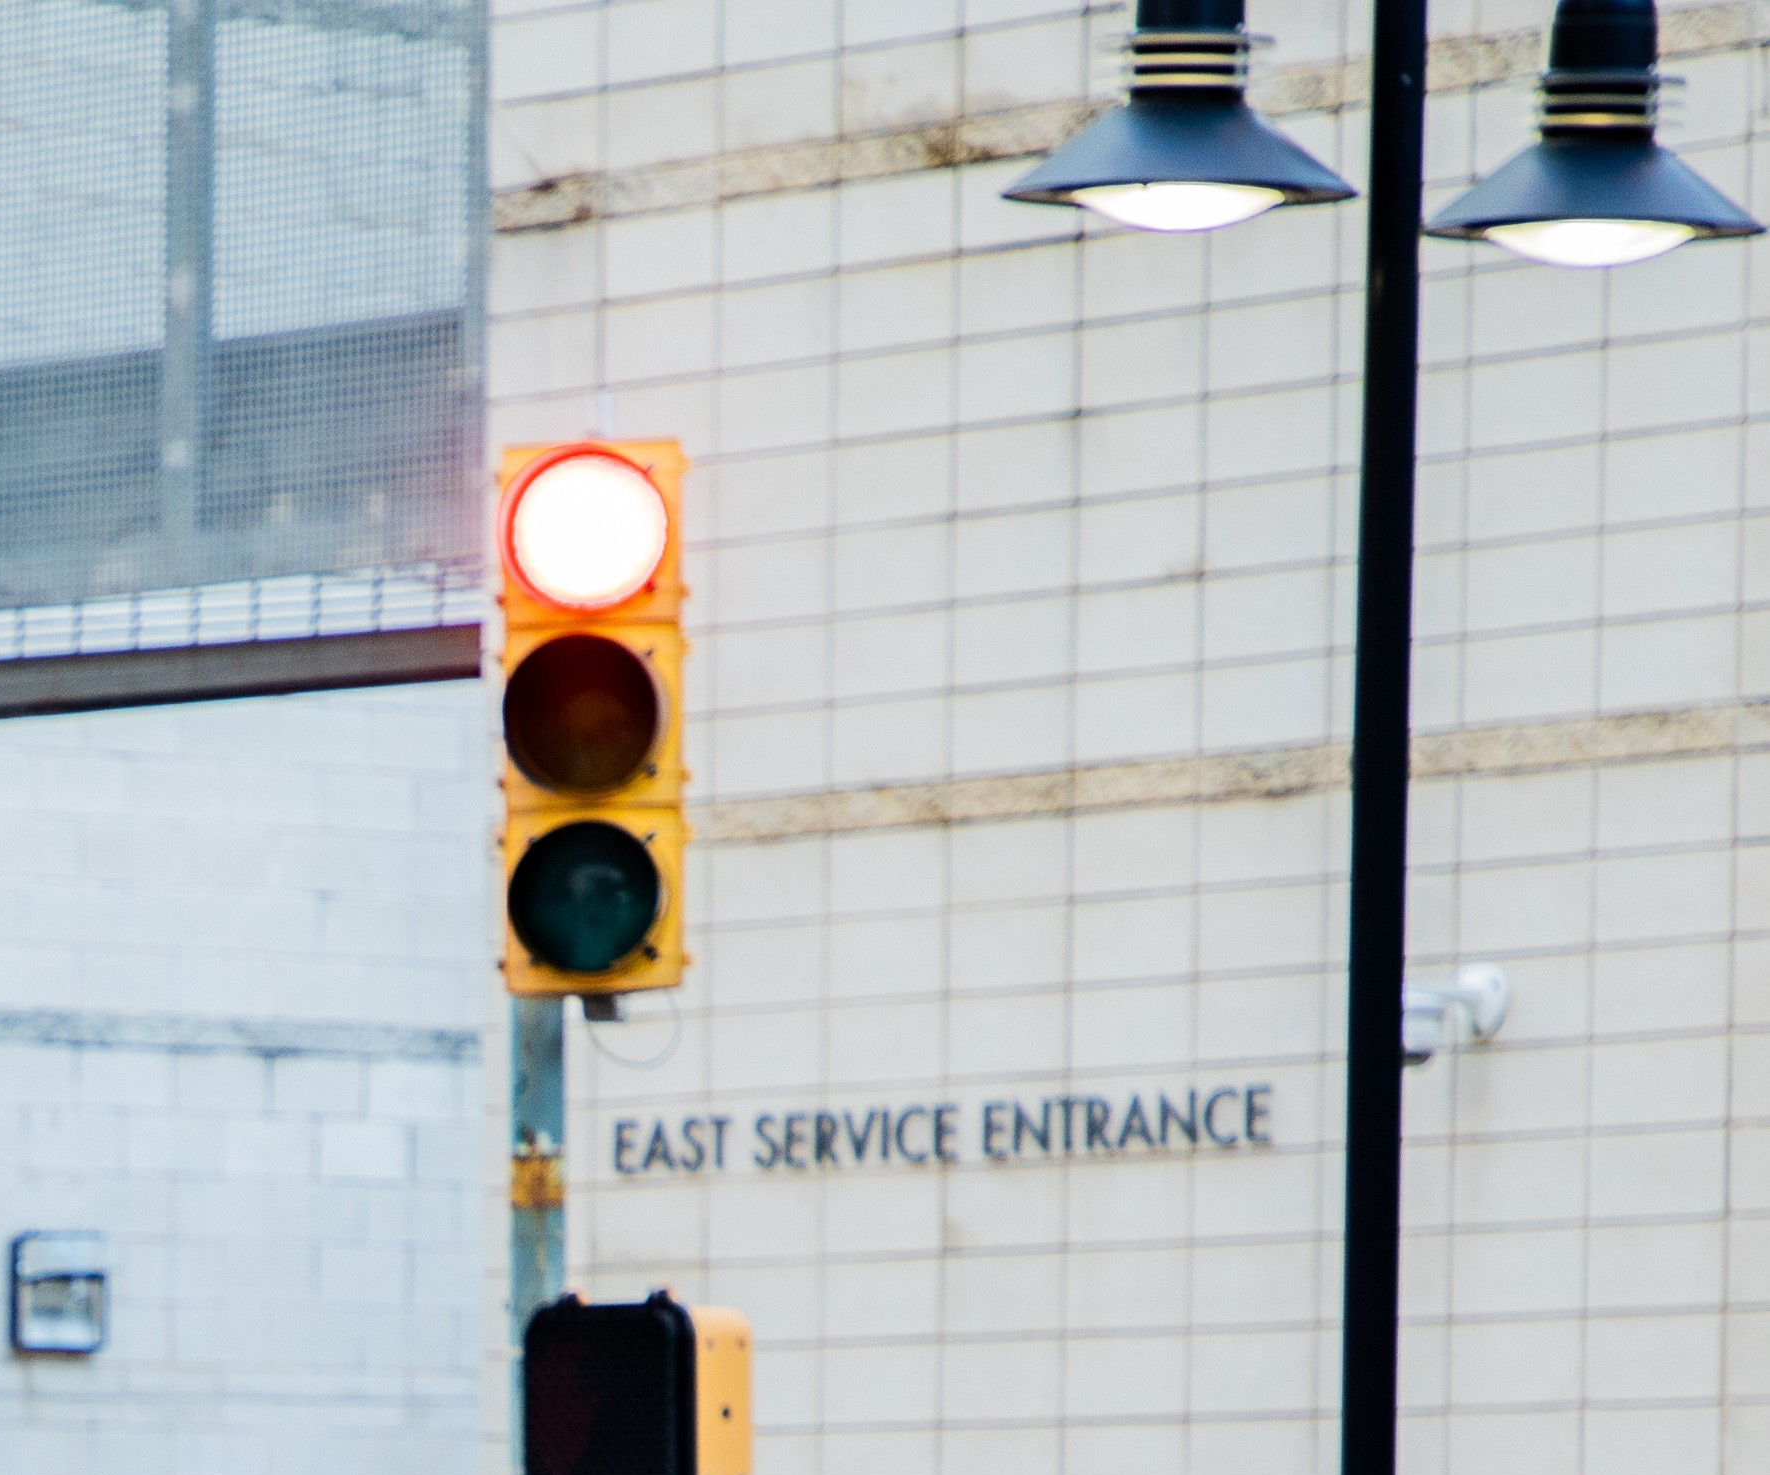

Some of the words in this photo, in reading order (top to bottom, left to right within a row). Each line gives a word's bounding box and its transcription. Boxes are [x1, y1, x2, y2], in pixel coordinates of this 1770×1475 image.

[613, 1115, 733, 1174] EAST
[752, 1104, 960, 1170] SERVICE
[982, 1083, 1273, 1159] ENTRANCE
